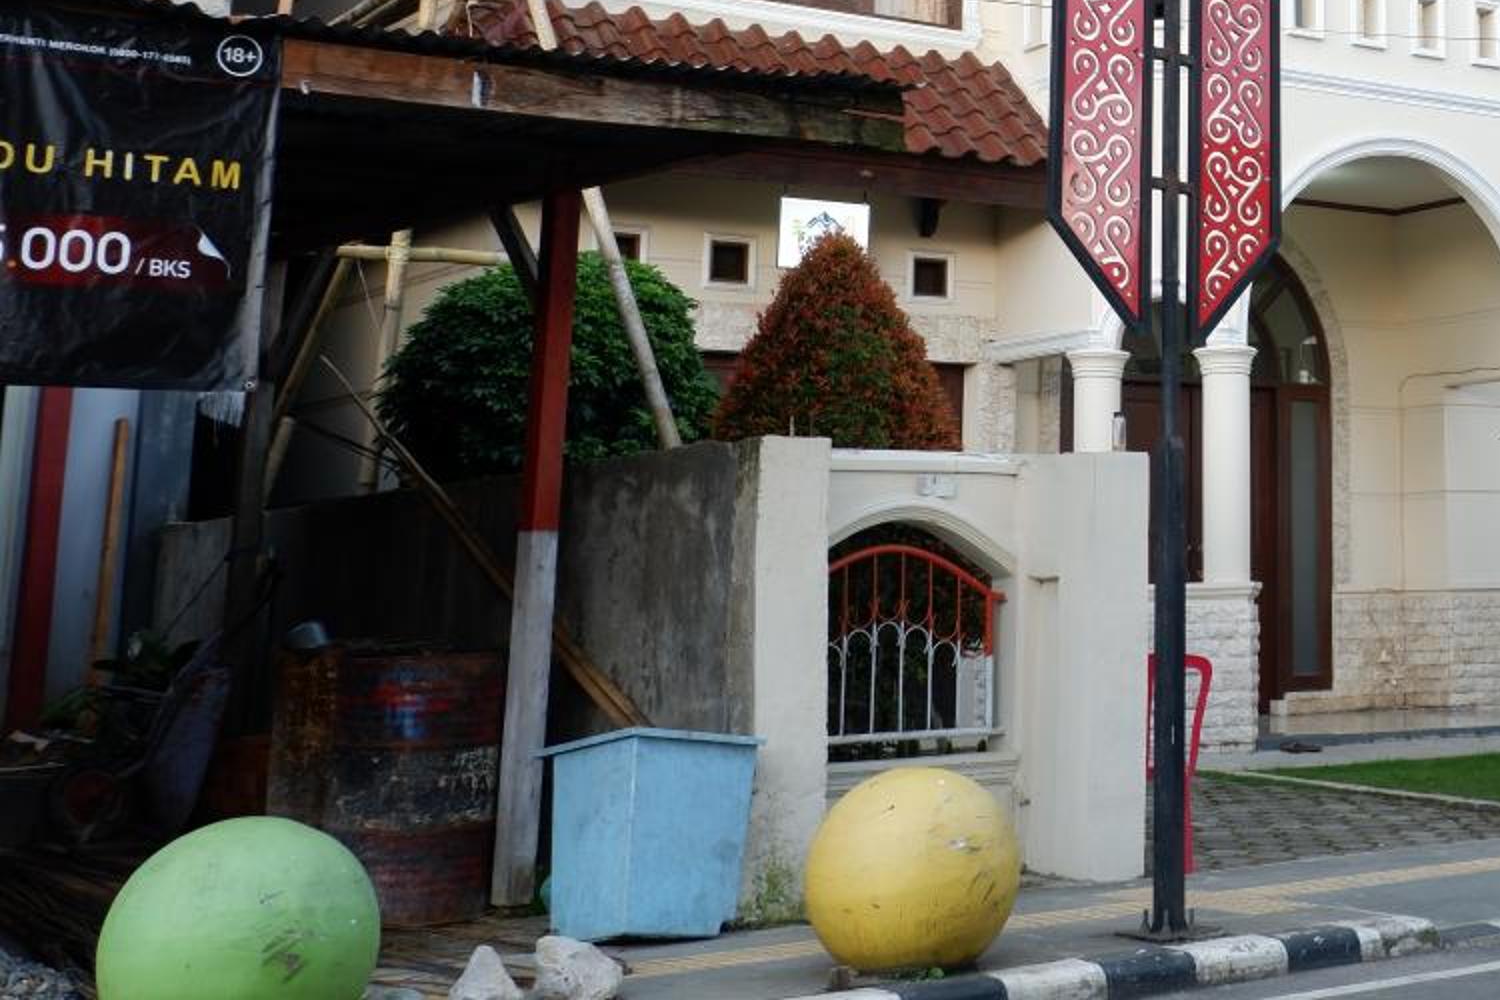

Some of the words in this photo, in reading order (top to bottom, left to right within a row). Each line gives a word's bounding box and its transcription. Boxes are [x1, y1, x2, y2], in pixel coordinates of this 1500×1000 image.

[224, 47, 256, 63] 18+
[85, 148, 241, 190] HITAM
[0, 224, 131, 275] .000
